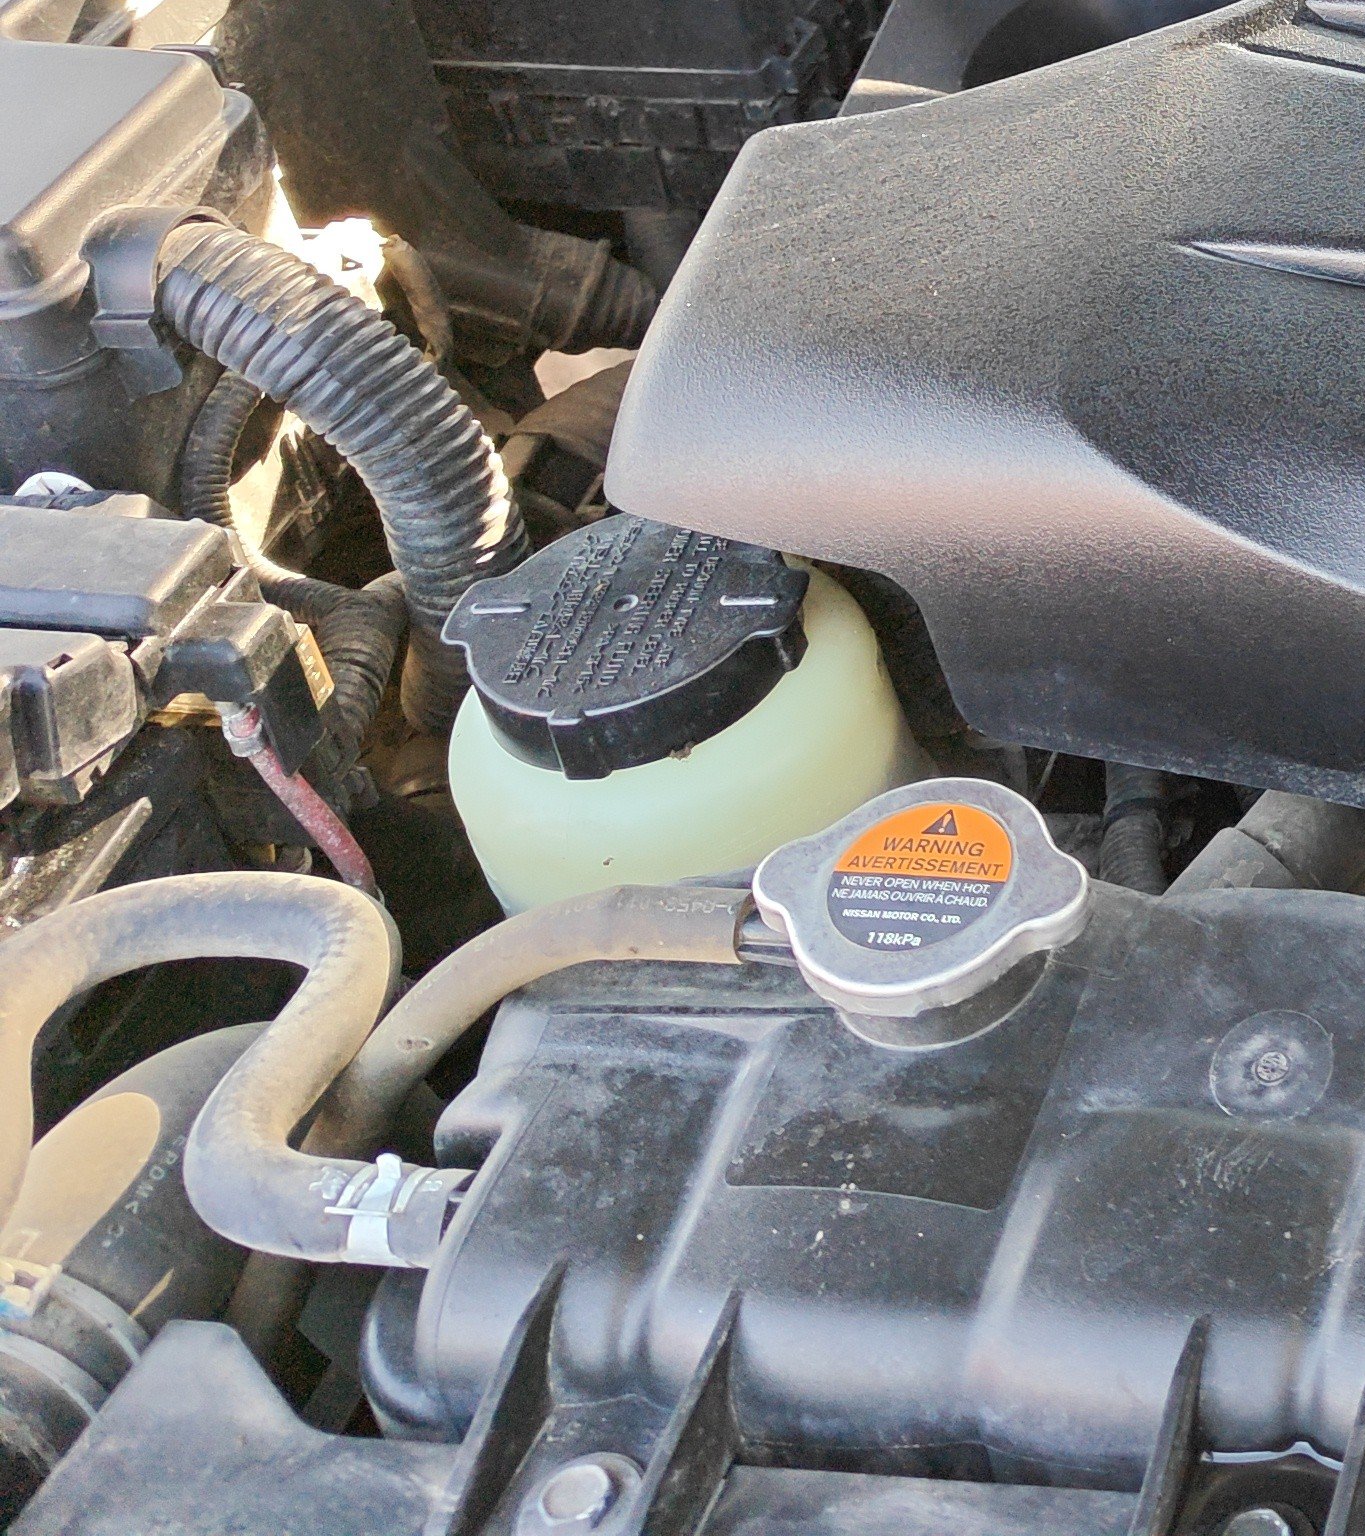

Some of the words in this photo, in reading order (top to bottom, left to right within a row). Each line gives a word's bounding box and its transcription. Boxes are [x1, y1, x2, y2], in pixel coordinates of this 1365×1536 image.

[621, 568, 673, 636] STEERING
[883, 836, 985, 857] WARNING
[847, 855, 1004, 876] AVERTISSEMENT
[841, 875, 884, 887] NEVER
[884, 877, 920, 889] OPEN
[922, 880, 960, 892] WHEN
[962, 883, 991, 895] HOT.
[831, 887, 850, 899] NE
[848, 889, 890, 901] JAMAIS
[890, 891, 936, 903] OUVRIR
[944, 894, 988, 907] CHAUD.
[842, 908, 881, 919] NISSAN
[881, 910, 920, 922] MOTOR
[941, 914, 962, 924] LTD.
[867, 931, 922, 947] 118kPa
